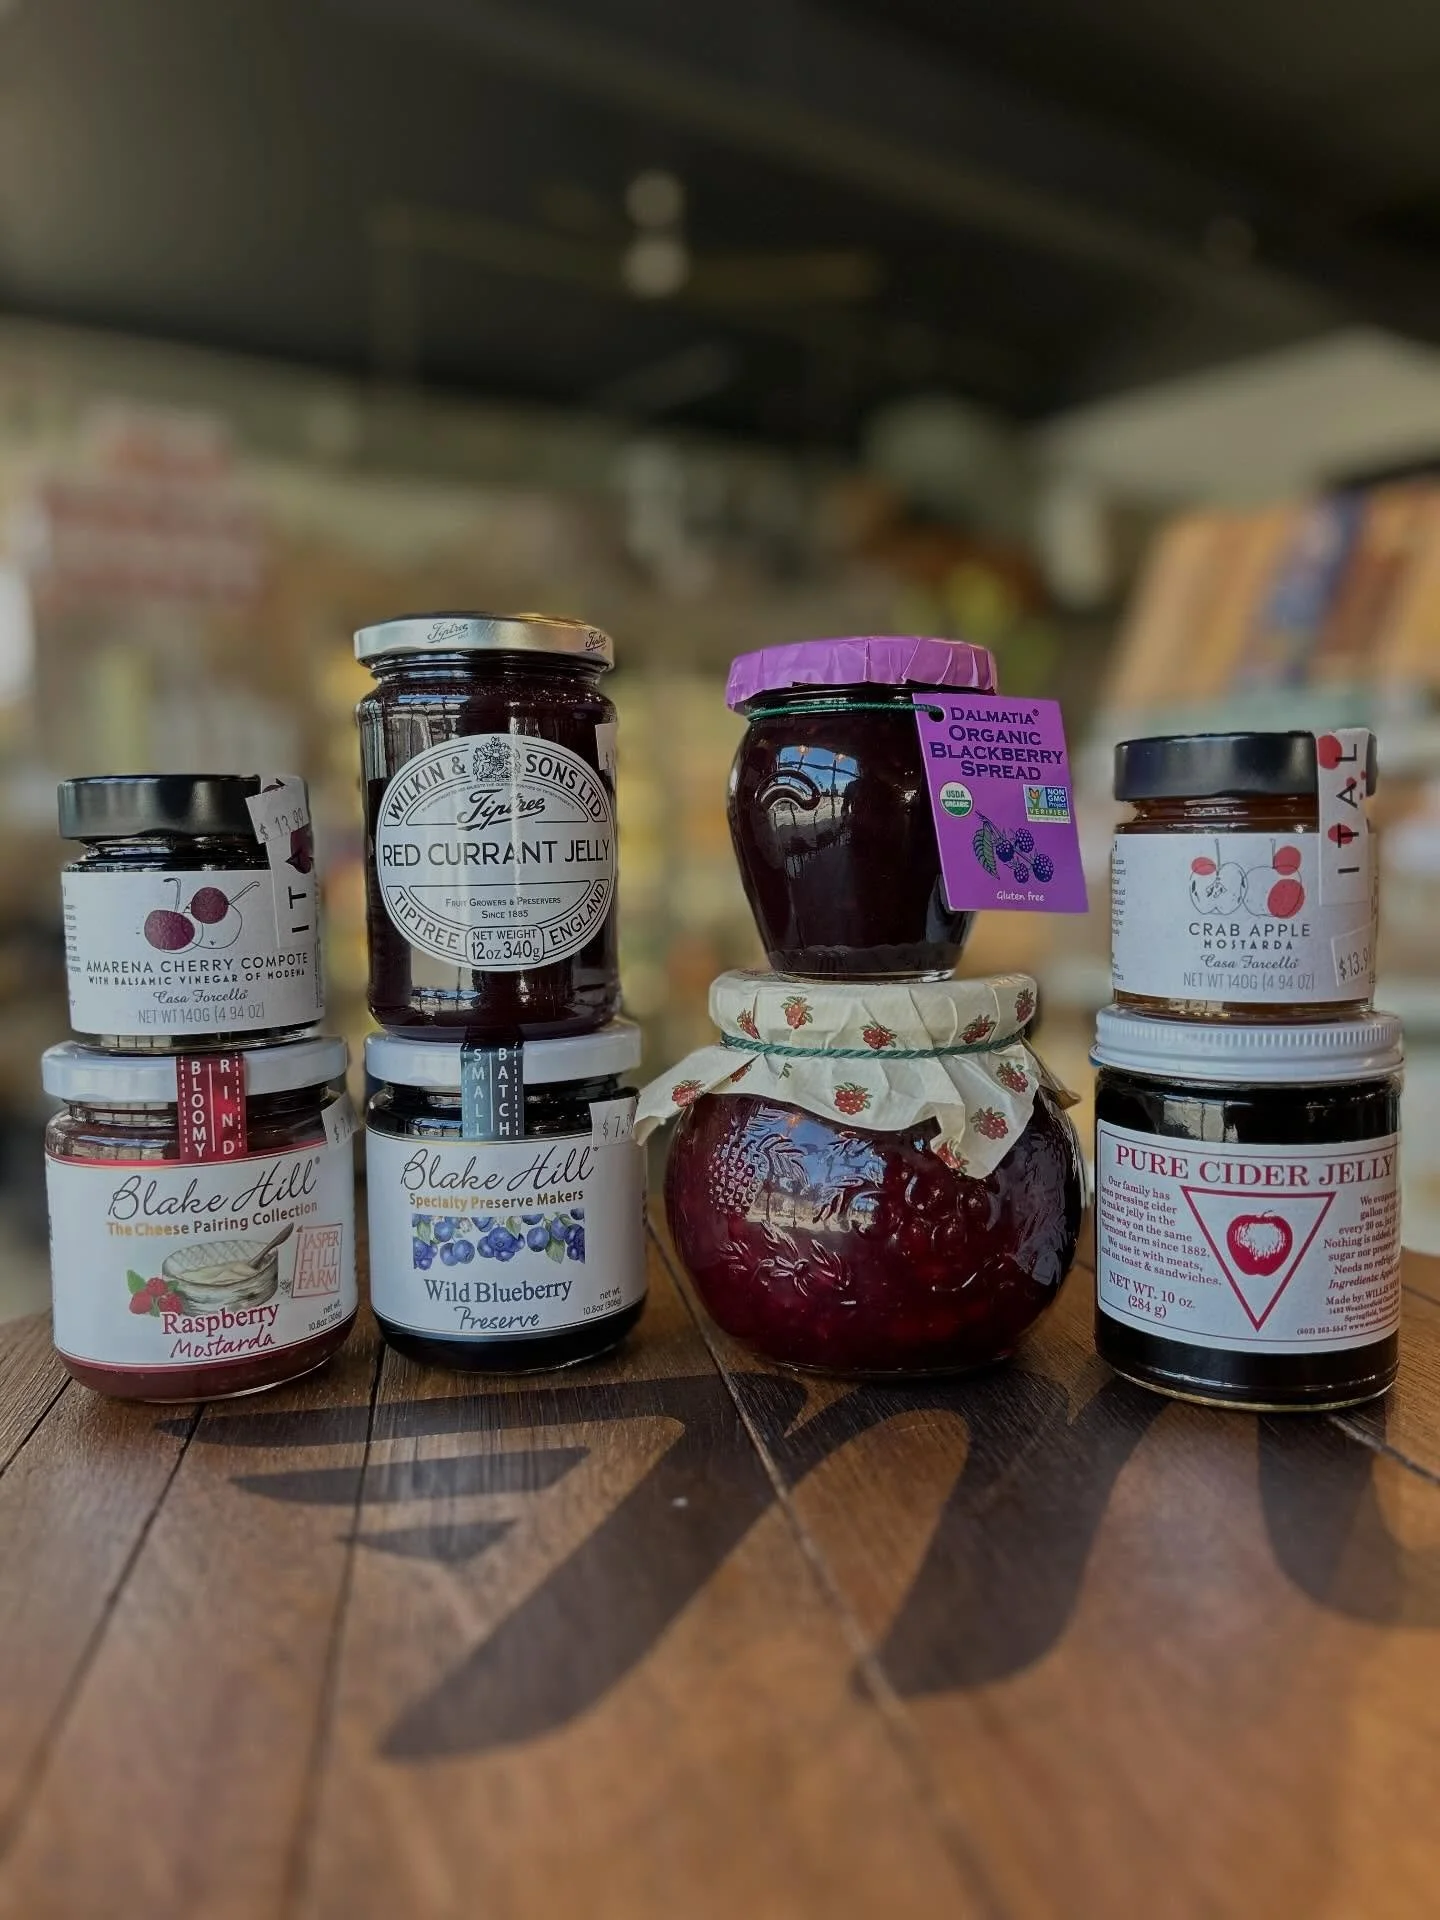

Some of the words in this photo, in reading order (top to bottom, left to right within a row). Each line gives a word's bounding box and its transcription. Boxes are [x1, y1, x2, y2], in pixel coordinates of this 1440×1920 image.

[948, 725, 1042, 746] ORGANIC
[929, 741, 1064, 765] BLACKBERRY
[961, 760, 1042, 782] SPREAD
[385, 760, 446, 821] WILKIN
[451, 755, 467, 776] &
[524, 753, 577, 793] SONS
[577, 780, 604, 820] LTD
[946, 790, 966, 799] USDA
[1047, 788, 1065, 796] NON
[1047, 795, 1065, 803] GMO
[1028, 807, 1068, 817] VERIFIED
[382, 843, 421, 867] RED
[428, 841, 558, 867] CURRANT
[564, 839, 609, 863] JELLY
[996, 891, 1026, 902] Gluten
[1027, 892, 1045, 902] free
[393, 890, 460, 950] TIPTREE
[548, 884, 605, 947] ENGLAND
[472, 931, 493, 941] NET
[497, 928, 538, 940] WEIGHT
[1188, 922, 1241, 937] CRAB
[1249, 923, 1311, 937] APPLE
[503, 940, 541, 961] 340g
[1203, 939, 1294, 951] MOSTARDA
[86, 959, 154, 974] AMARENA
[160, 958, 234, 973] CHERRY
[240, 952, 309, 970] COMPOTE
[1200, 954, 1237, 969] Casa
[88, 975, 109, 986] WITH
[114, 976, 173, 986] BALSAMIC
[179, 974, 239, 985] VINEGAR
[245, 972, 260, 983] OF
[267, 969, 305, 981] MODENA
[1183, 971, 1204, 987] NET
[1207, 972, 1226, 988] WT
[1227, 972, 1258, 989] 140G
[153, 990, 190, 1004] Casa
[138, 1009, 157, 1024] NET
[159, 1008, 178, 1023] WT
[180, 1006, 211, 1023] 140G
[472, 1048, 485, 1136] SMALL
[498, 1047, 511, 1136] BATCH
[191, 1060, 208, 1159] BLOOMY
[219, 1059, 235, 1155] RIND
[400, 1148, 505, 1192] Blake
[507, 1145, 595, 1192] Hill
[1115, 1143, 1190, 1181] PURE
[1199, 1160, 1311, 1190] CIDER
[1319, 1151, 1395, 1187] JELLY
[107, 1175, 230, 1220] Blake
[230, 1158, 318, 1213] Hill
[1108, 1175, 1121, 1187] Our
[1122, 1181, 1150, 1197] family
[1152, 1188, 1171, 1201] has
[409, 1192, 468, 1213] Specialty
[471, 1193, 533, 1210] Preserve
[536, 1190, 585, 1206] Makers
[1114, 1191, 1149, 1211] pressing
[1151, 1201, 1177, 1215] cider
[1360, 1195, 1372, 1206] We
[106, 1221, 133, 1238] The
[134, 1220, 189, 1238] Cheese
[193, 1215, 250, 1235] Pairing
[253, 1199, 318, 1227] Collection
[1107, 1200, 1125, 1214] make
[1126, 1205, 1145, 1221] jelly
[1146, 1211, 1157, 1222] in
[1159, 1215, 1176, 1227] the
[1360, 1207, 1383, 1221] gallon
[304, 1230, 340, 1250] JASPER
[1116, 1216, 1131, 1230] way
[1133, 1223, 1144, 1232] on
[1146, 1225, 1162, 1238] the
[1164, 1232, 1193, 1245] same
[1324, 1236, 1363, 1250] Nothing
[1364, 1233, 1371, 1244] is
[1339, 1224, 1363, 1235] every
[1107, 1235, 1118, 1248] We
[1119, 1242, 1132, 1255] use
[1133, 1246, 1142, 1258] it
[1142, 1249, 1165, 1264] with
[1166, 1256, 1204, 1273] meats,
[1128, 1231, 1151, 1247] farm
[1152, 1238, 1179, 1255] since
[1182, 1245, 1211, 1260] 1882.
[1328, 1250, 1356, 1264] sugar
[1357, 1248, 1371, 1258] nor
[300, 1247, 338, 1271] HILL
[1111, 1251, 1121, 1263] on
[1121, 1256, 1142, 1271] toast
[1143, 1262, 1153, 1273] &
[1154, 1266, 1223, 1288] sandwiches.
[1334, 1260, 1363, 1275] Needs
[1364, 1262, 1374, 1271] no
[296, 1268, 338, 1291] FARM
[423, 1279, 470, 1303] Wild
[474, 1279, 573, 1304] Blueberry
[1108, 1270, 1131, 1291] NET
[1133, 1280, 1158, 1301] WT.
[1161, 1290, 1176, 1305] 10
[1178, 1298, 1197, 1311] oz.
[1128, 1295, 1152, 1314] (284
[1154, 1304, 1168, 1321] g)
[1326, 1295, 1351, 1307] Made
[162, 1303, 280, 1337] Raspberry
[453, 1305, 540, 1330] Preserve
[170, 1325, 276, 1358] Mostarda
